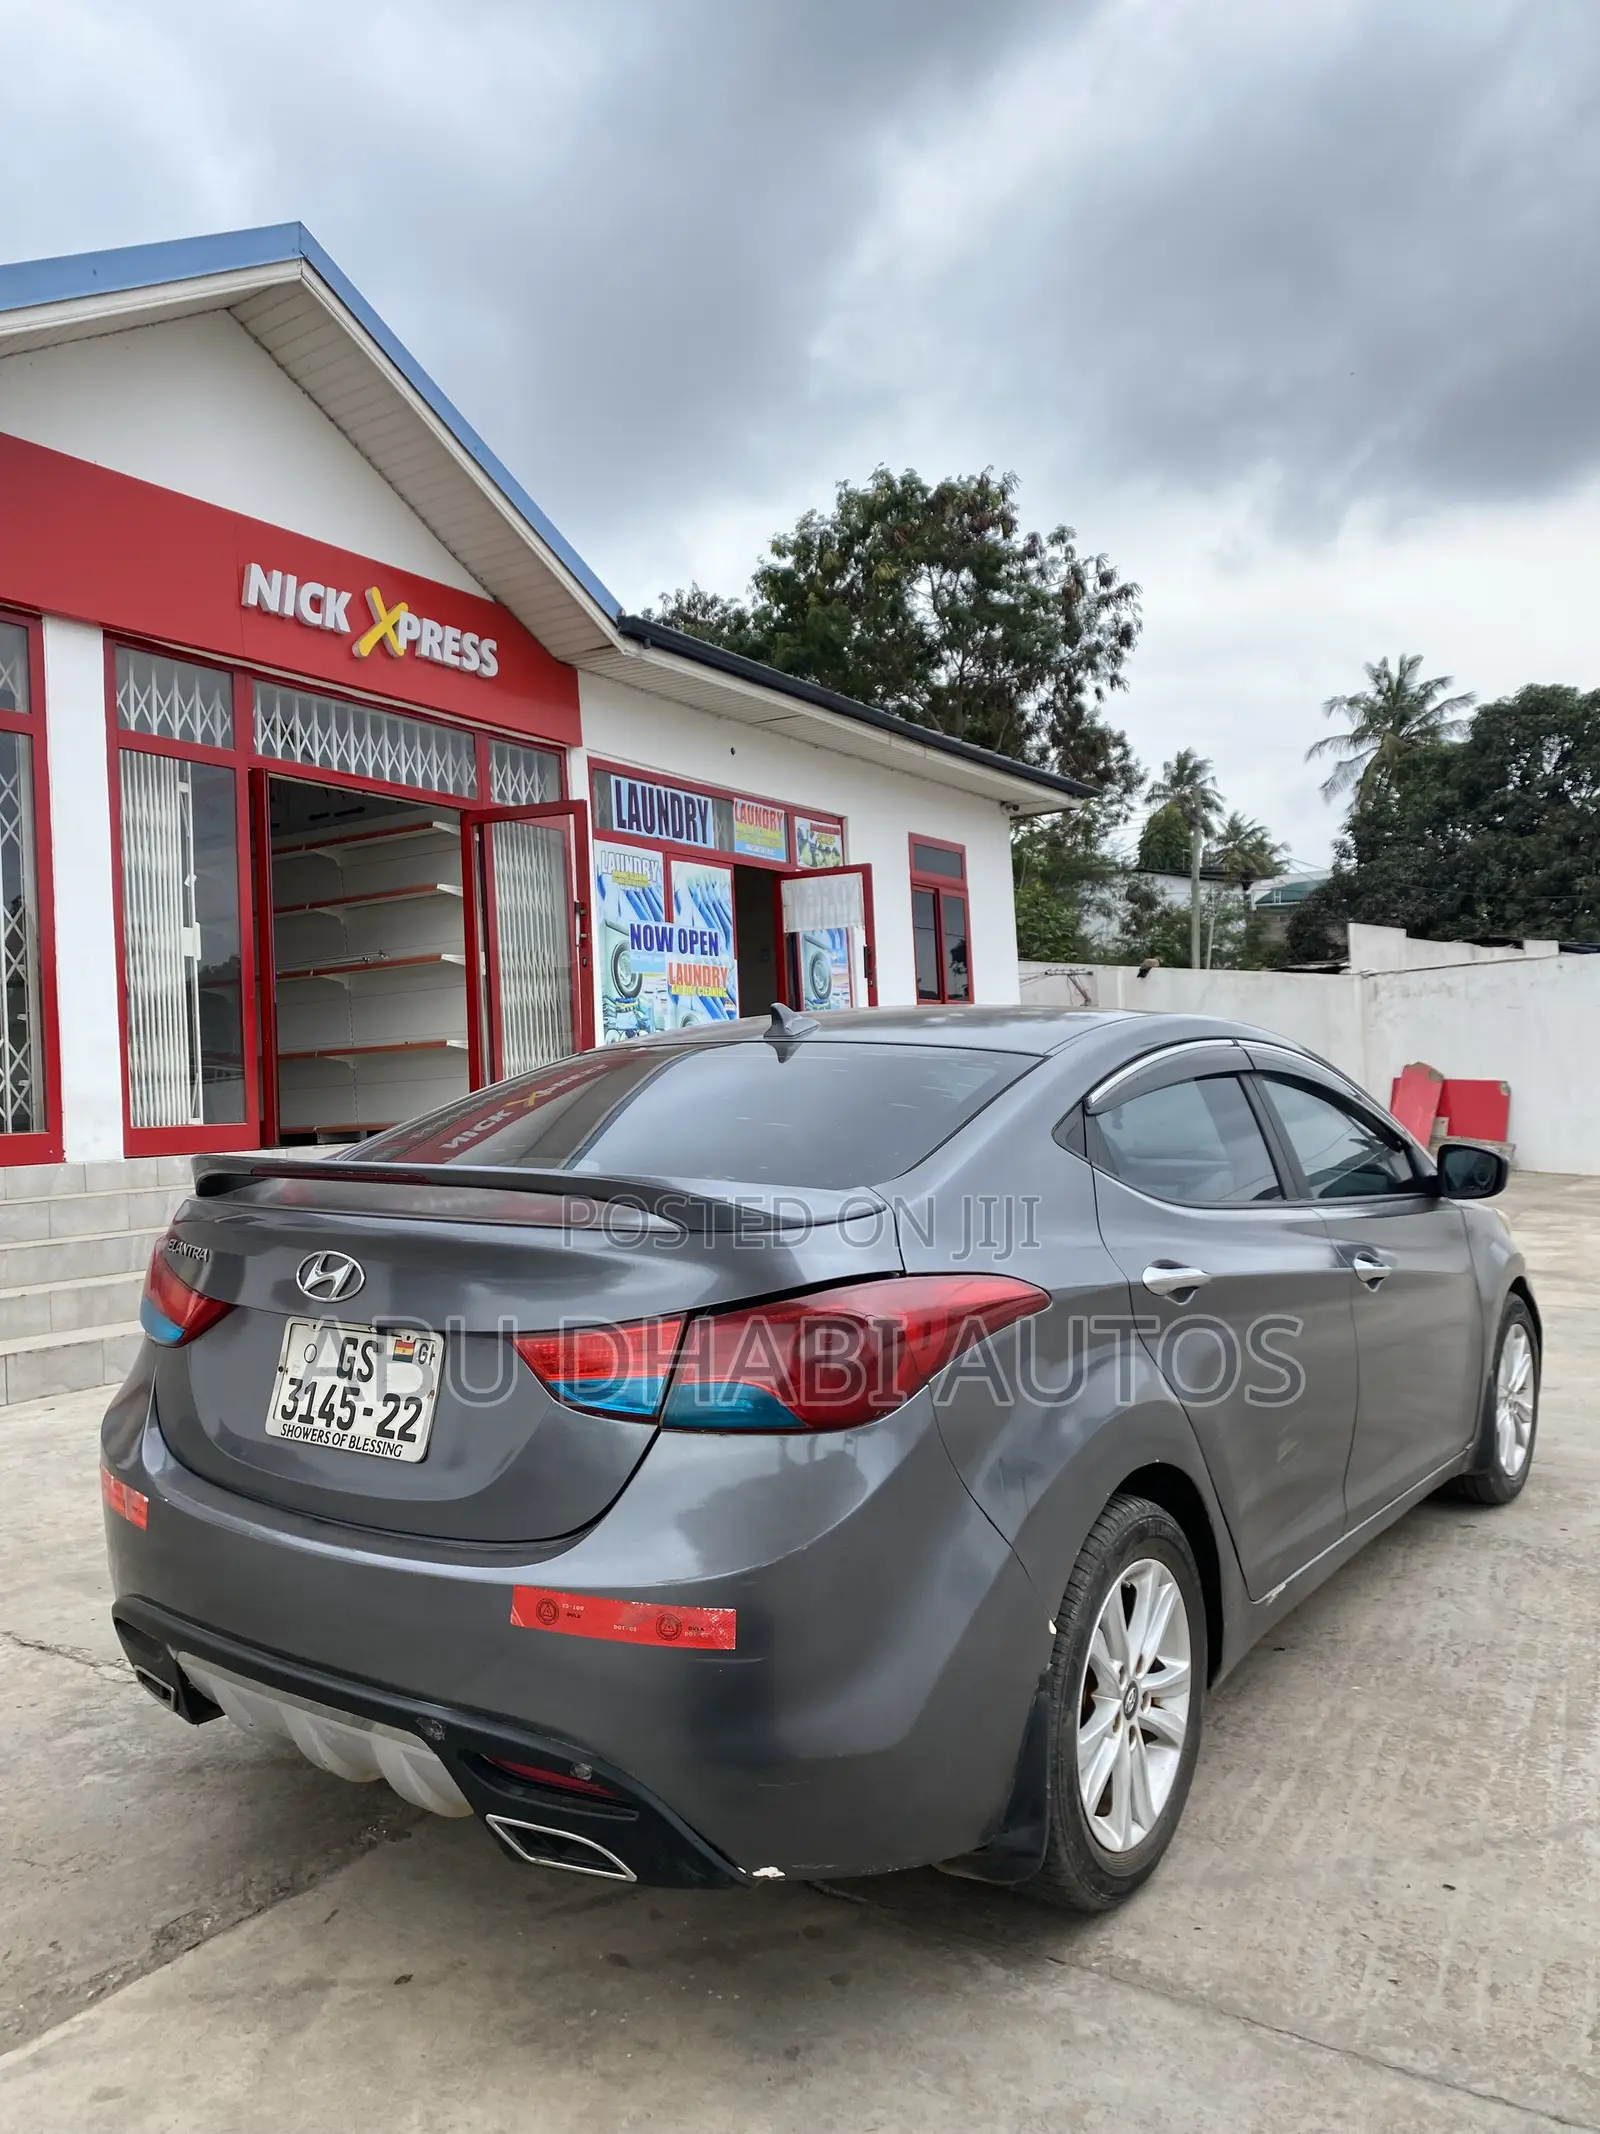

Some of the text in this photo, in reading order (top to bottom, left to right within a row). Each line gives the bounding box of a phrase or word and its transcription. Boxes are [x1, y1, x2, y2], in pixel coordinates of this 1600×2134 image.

[241, 562, 499, 679] NICK XPRESS
[615, 779, 708, 844] LAUNDRY
[734, 800, 783, 832] LAUNDRY
[601, 850, 659, 883] LAUNDRY
[630, 923, 719, 957] NOW OPEN
[668, 962, 728, 988] LAUNDRY
[168, 1238, 210, 1262] ELANTRA
[336, 1337, 380, 1383] GS
[280, 1423, 403, 1458] SHOWERS OF BLESSING
